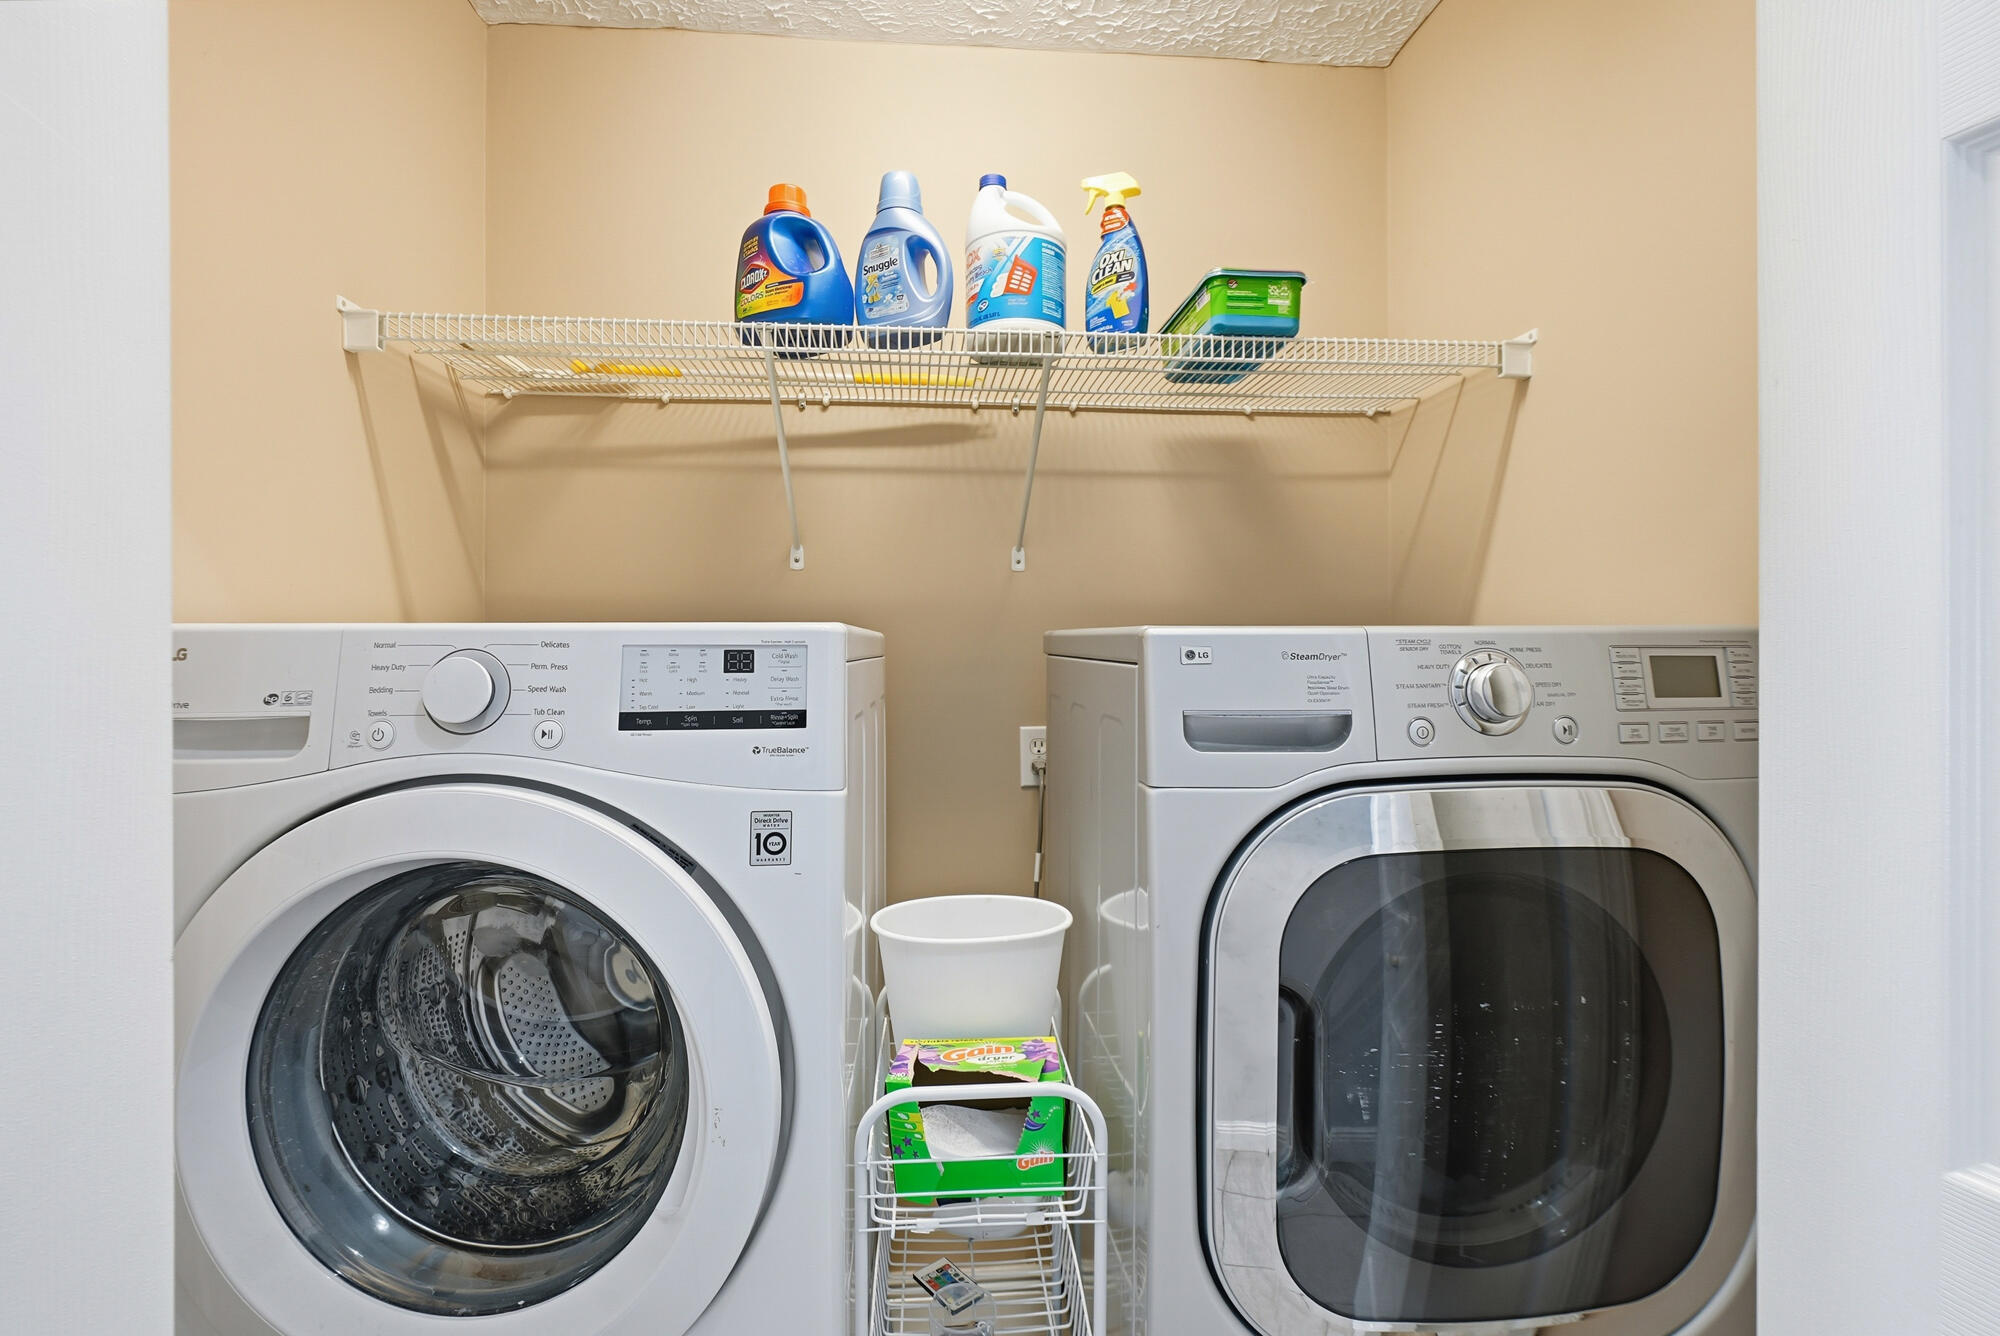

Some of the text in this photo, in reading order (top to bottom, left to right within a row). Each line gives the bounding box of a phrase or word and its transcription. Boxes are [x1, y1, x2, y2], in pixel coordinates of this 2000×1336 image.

[863, 257, 898, 276] Snuggle
[1099, 249, 1125, 269] OXI
[1091, 258, 1133, 285] CLEAN
[540, 641, 570, 649] Delicates
[371, 664, 406, 672] Heavy Duty
[550, 663, 568, 671] Press
[369, 686, 393, 694] Bedding
[527, 685, 567, 693] Speed Wash
[755, 831, 787, 855] 10
[941, 1044, 1015, 1062] Gain
[1017, 1150, 1054, 1171] Gain
